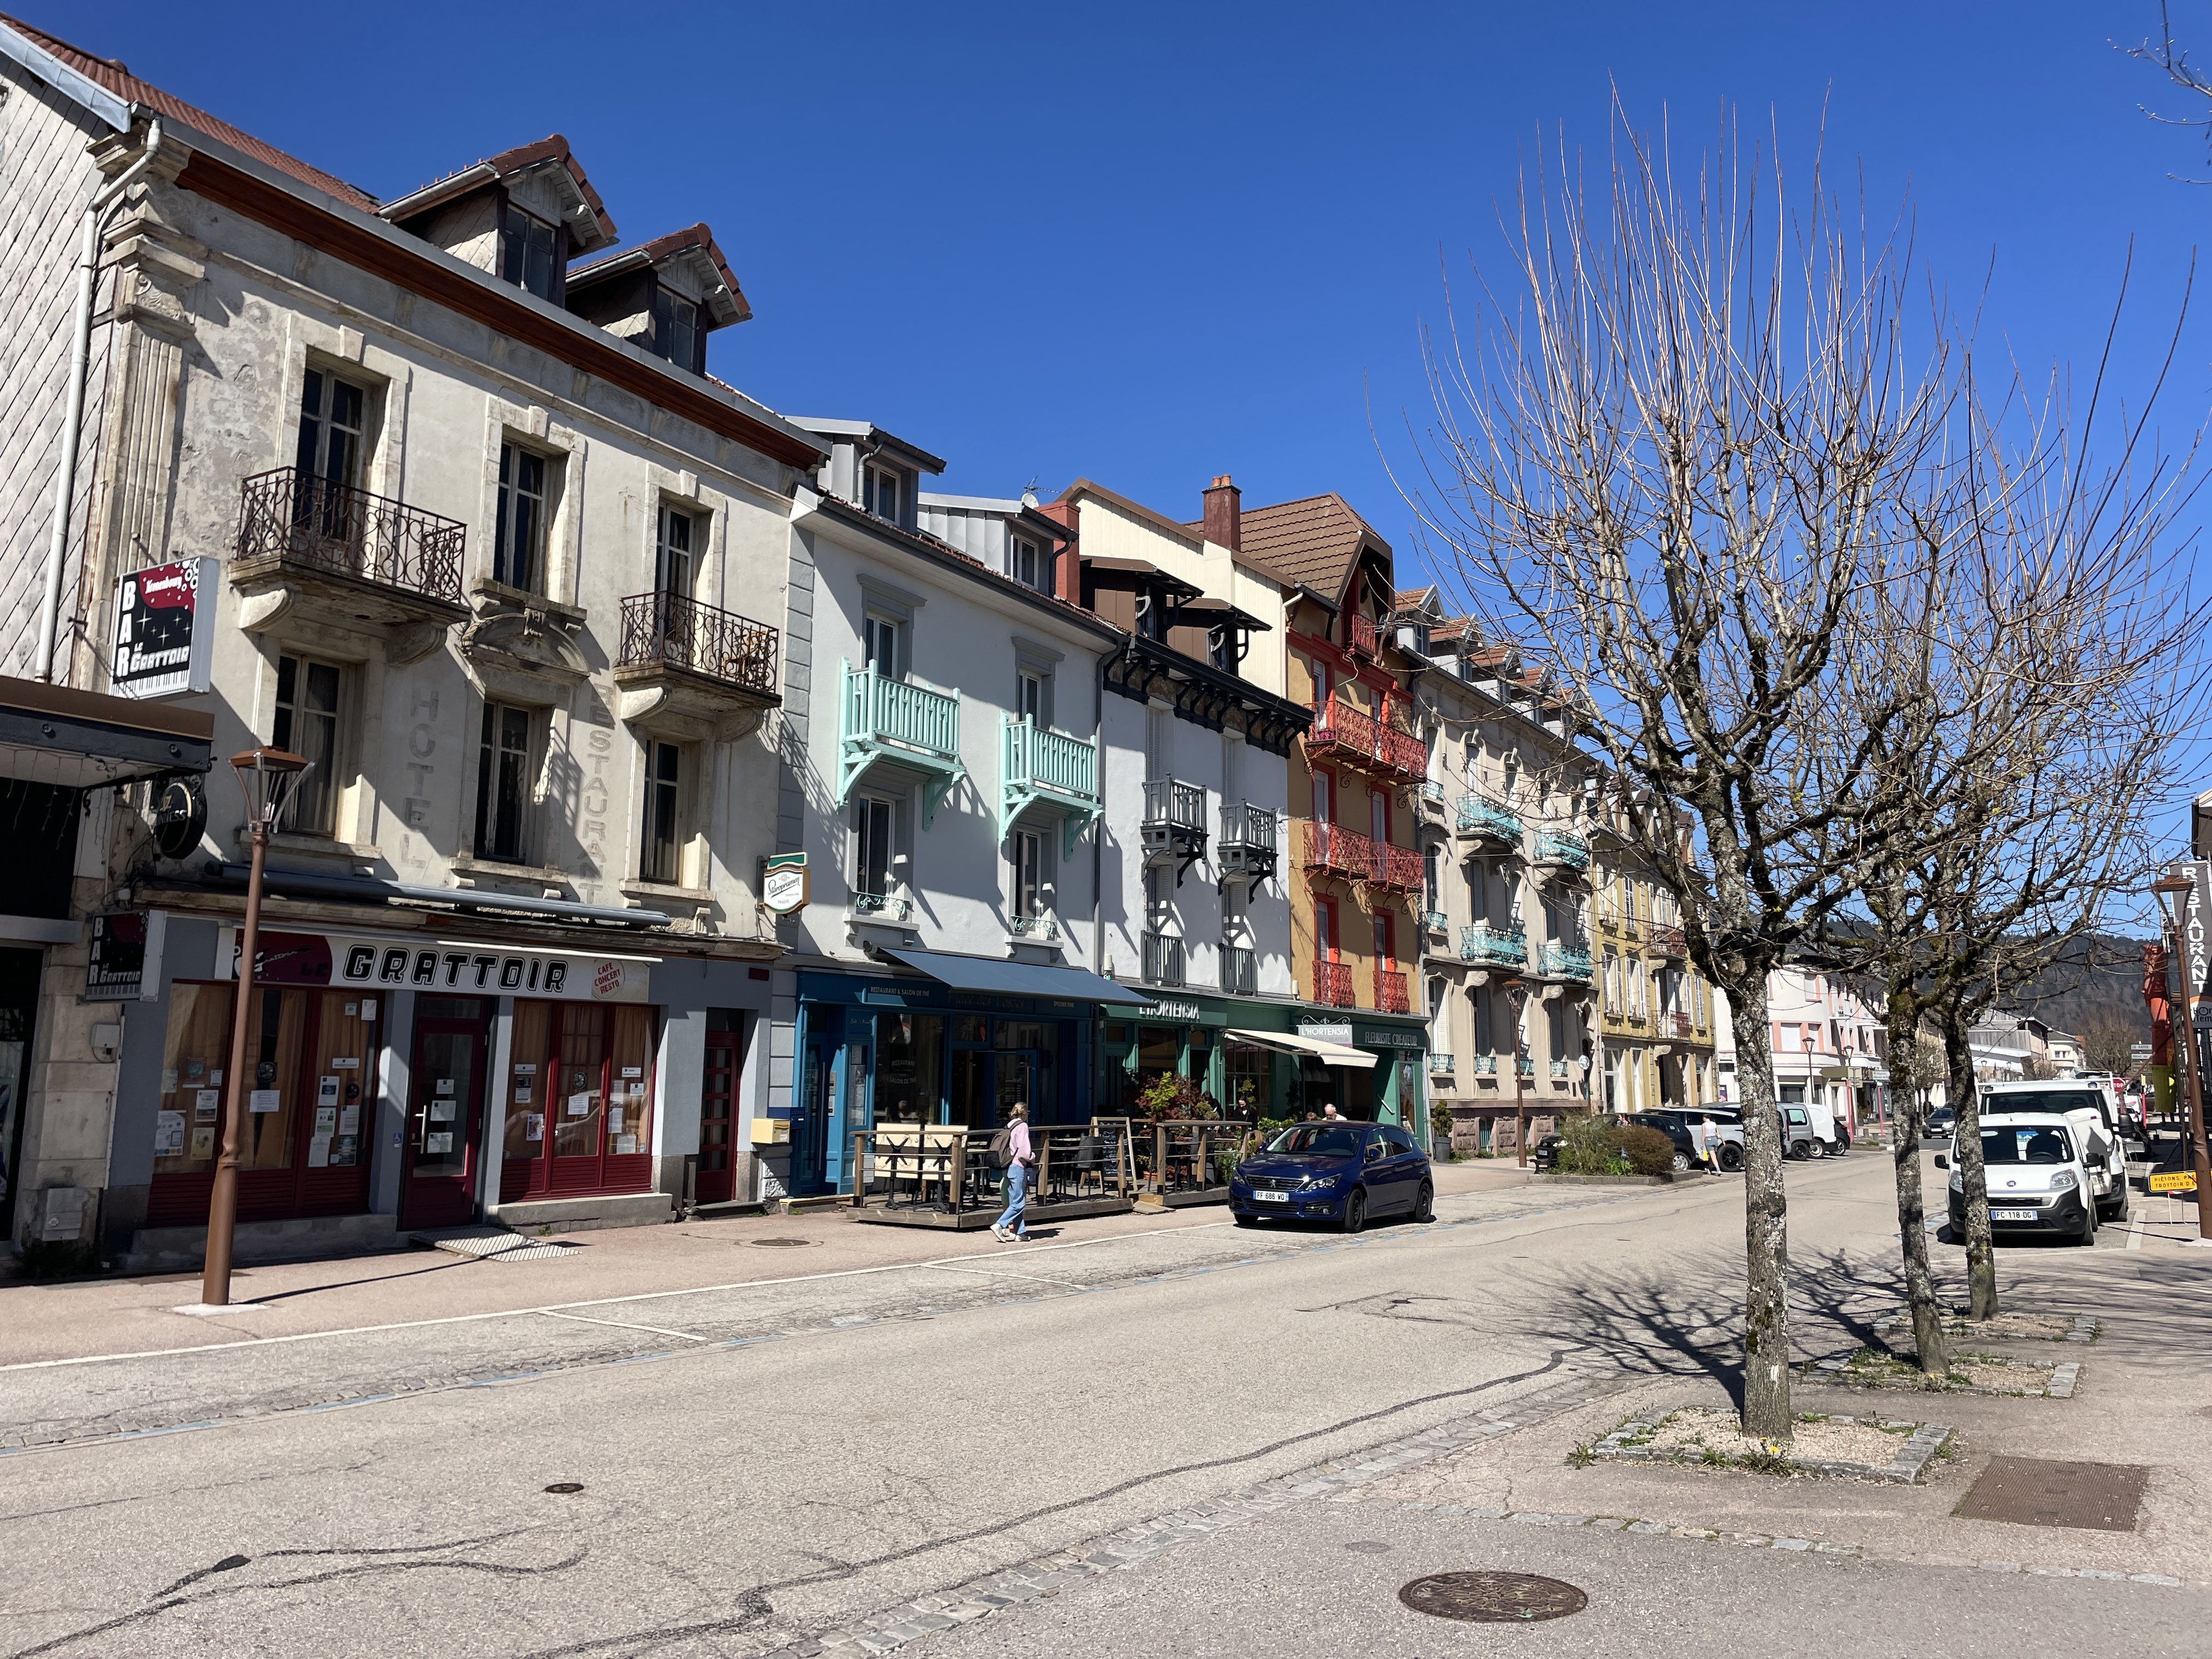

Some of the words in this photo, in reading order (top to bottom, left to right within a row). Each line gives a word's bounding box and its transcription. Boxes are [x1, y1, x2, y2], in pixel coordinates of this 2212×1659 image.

[116, 580, 137, 677] BAR
[129, 646, 190, 673] GRATTOIR
[400, 687, 439, 868] HOTEL
[577, 682, 614, 905] RESTAURANT
[88, 917, 104, 985] BAR
[99, 970, 141, 983] GRATTOIR
[343, 944, 569, 992] GRATTOIR
[595, 969, 620, 986] CONCERT
[598, 962, 613, 975] CAFE
[600, 979, 619, 994] RESTO
[1139, 998, 1201, 1019] LHORTENSIA
[1301, 1028, 1349, 1036] L'HORTENSIA
[1364, 1031, 1391, 1045] FLEURISTE
[1392, 1034, 1418, 1047] CREATEUR
